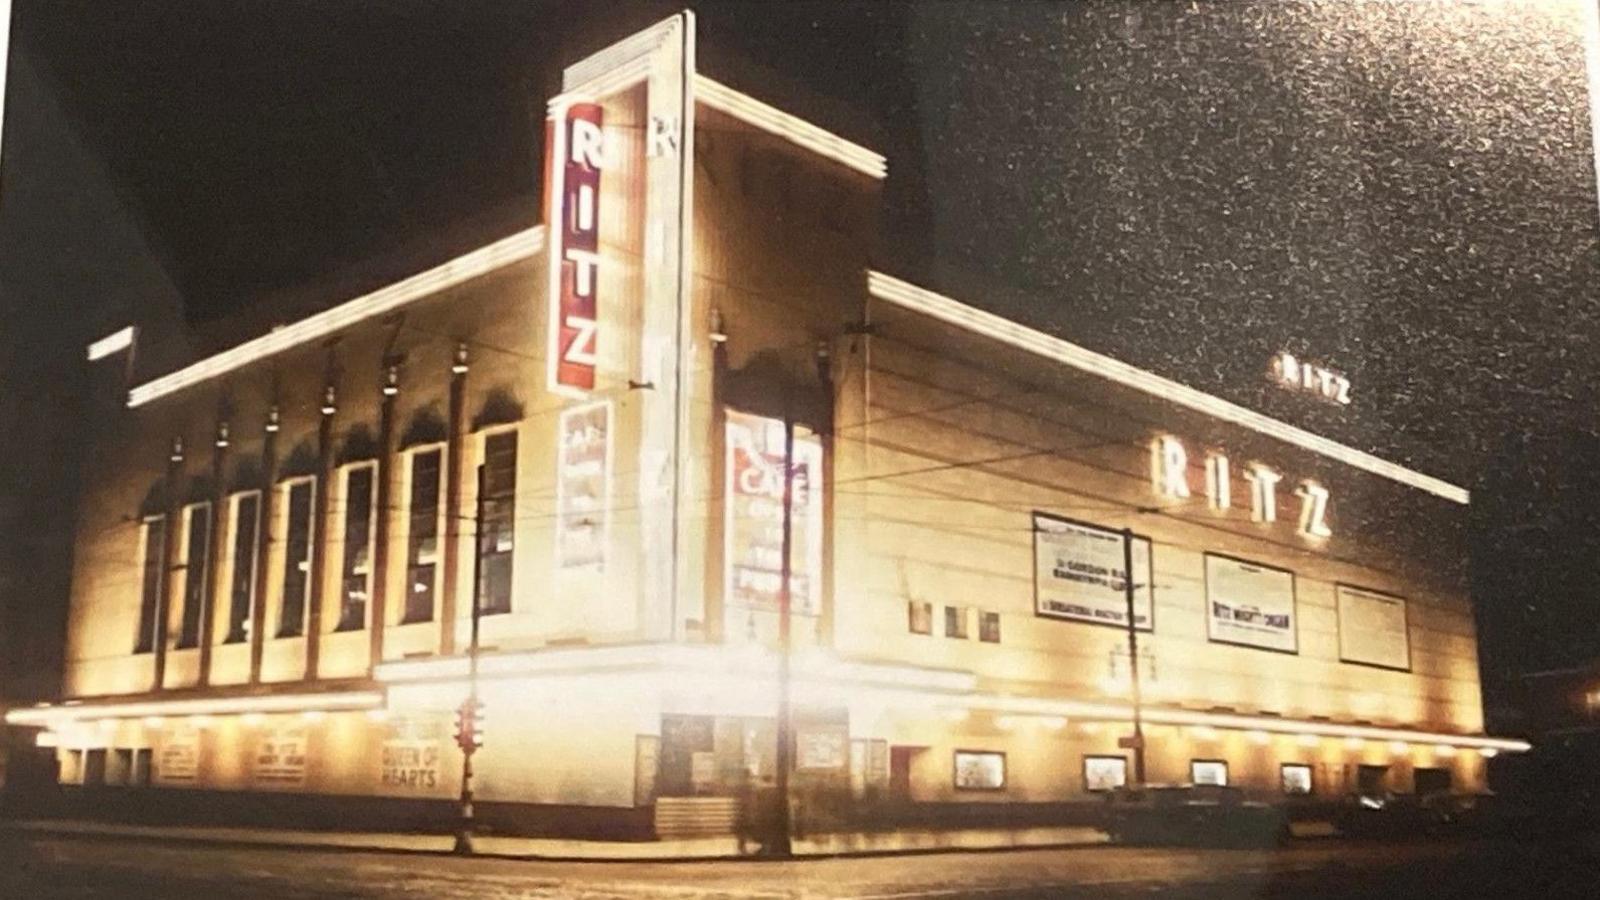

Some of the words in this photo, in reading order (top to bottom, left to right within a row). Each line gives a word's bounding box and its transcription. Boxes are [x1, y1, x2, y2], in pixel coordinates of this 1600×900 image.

[564, 116, 604, 366] RITZ
[1272, 352, 1351, 405] RITZ
[1151, 432, 1332, 538] RITZ
[382, 768, 436, 788] HEARTS
